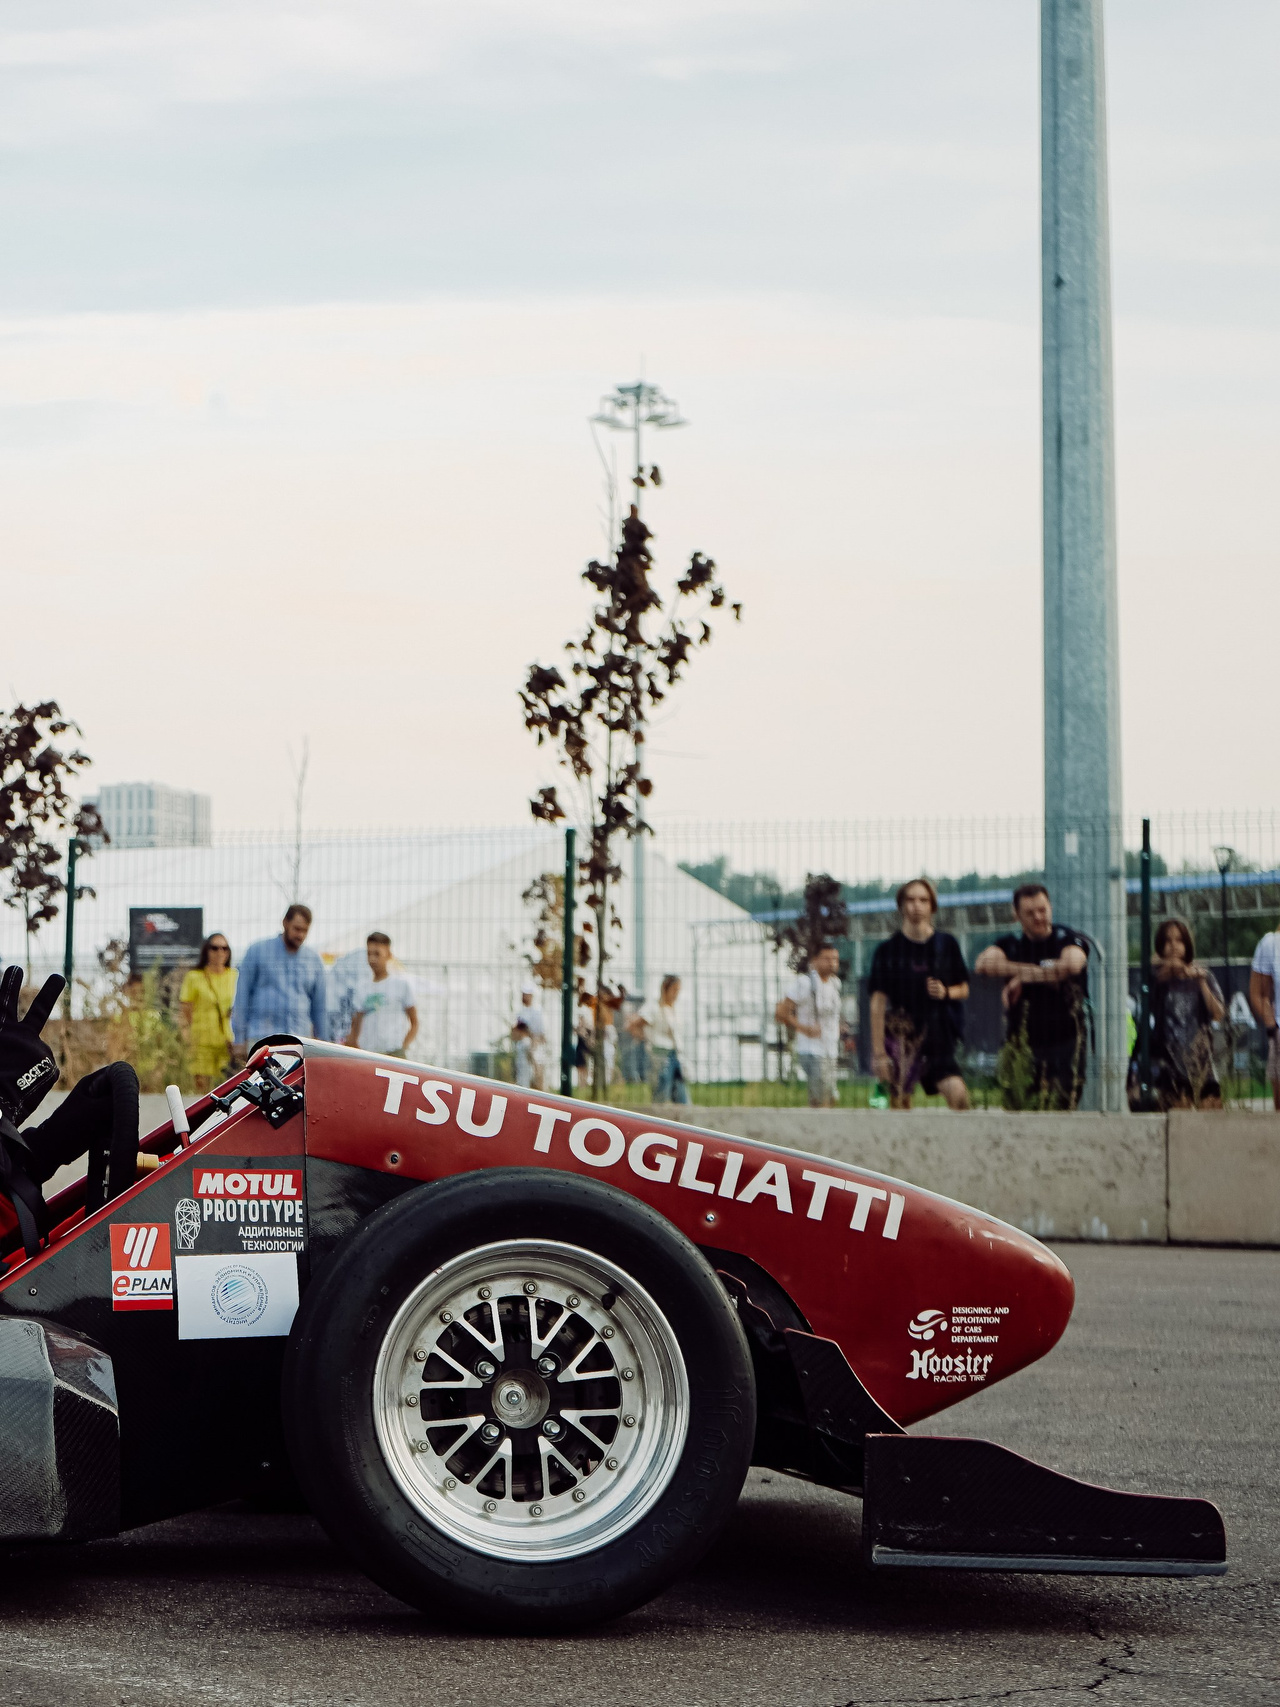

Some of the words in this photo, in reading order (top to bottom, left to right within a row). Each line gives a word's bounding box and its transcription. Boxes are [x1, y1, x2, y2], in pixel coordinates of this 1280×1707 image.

[375, 1067, 508, 1139] TSU
[526, 1103, 906, 1241] TOGLIATTI
[198, 1173, 297, 1196] MOTUL
[204, 1199, 304, 1223] PROTOTYPE
[238, 1226, 304, 1238] АДДИТИВНЫЕ
[242, 1240, 305, 1252] ТЕХНОЛОГИИ
[952, 1306, 991, 1315] DESIGNING
[994, 1307, 1009, 1315] AND
[951, 1316, 1000, 1324] EXPLOITATION
[951, 1335, 999, 1343] DEPARTAMENT
[905, 1347, 994, 1380] Hoosier
[933, 1374, 967, 1383] RACING
